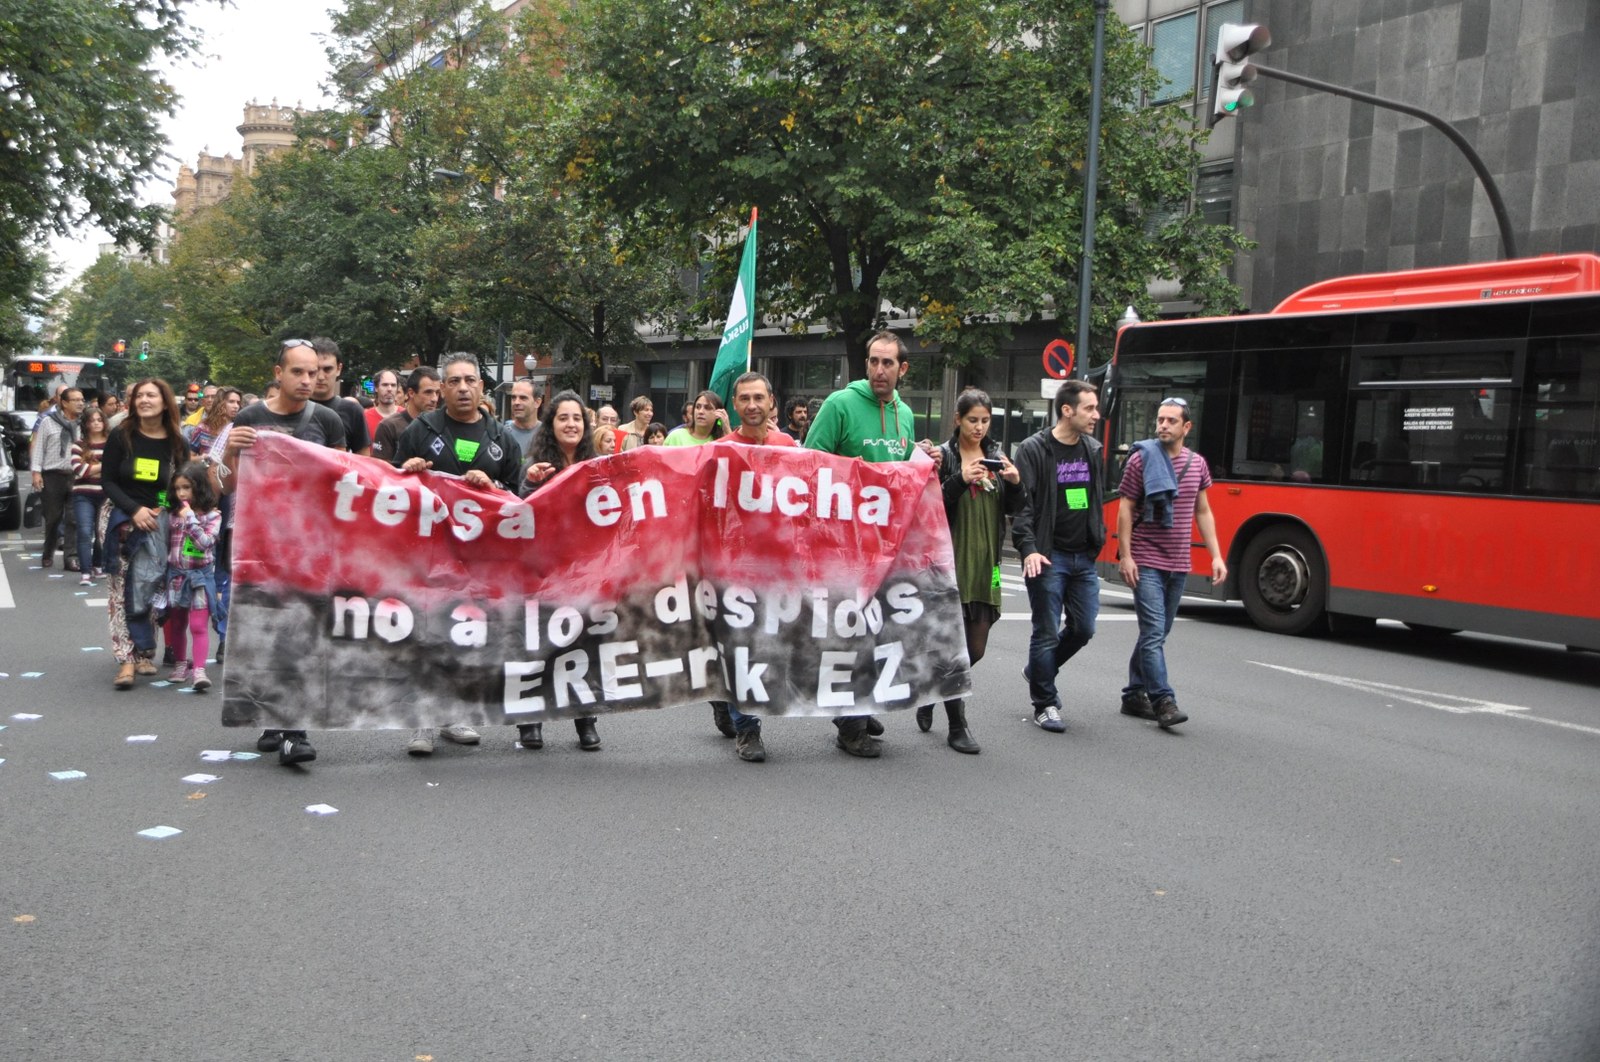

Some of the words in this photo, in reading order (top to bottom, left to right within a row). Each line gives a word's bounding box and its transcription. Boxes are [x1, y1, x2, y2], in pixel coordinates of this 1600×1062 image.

[333, 470, 535, 542] tepsa
[585, 478, 667, 527] en
[713, 457, 891, 527] lucha
[331, 595, 414, 643] no
[450, 604, 487, 648] a
[525, 600, 619, 650] los
[654, 572, 924, 639] despidos
[816, 641, 910, 707] EZ
